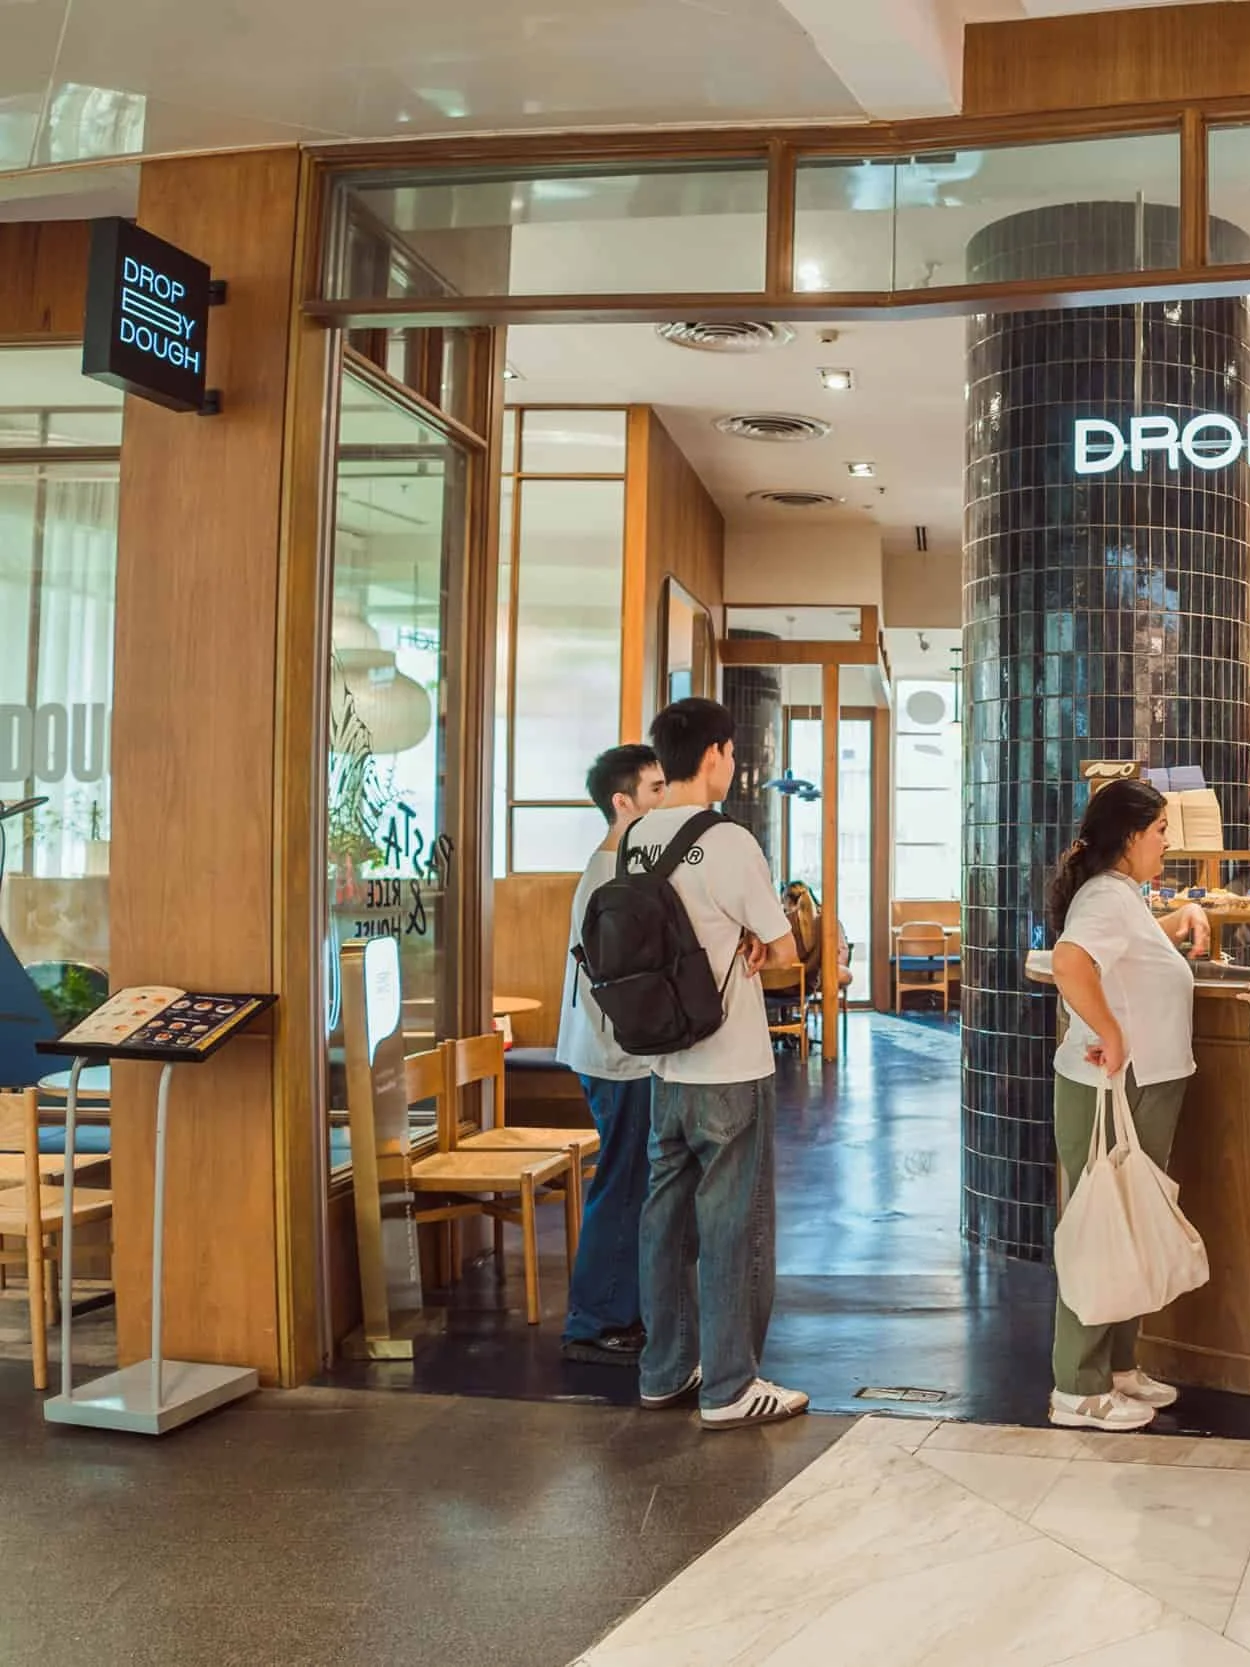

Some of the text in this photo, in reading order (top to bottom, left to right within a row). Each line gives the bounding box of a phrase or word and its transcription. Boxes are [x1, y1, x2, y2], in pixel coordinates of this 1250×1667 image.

[123, 256, 186, 304] DROP
[121, 287, 195, 341] BY
[120, 317, 201, 374] DOUGH
[0, 703, 111, 783] DOU
